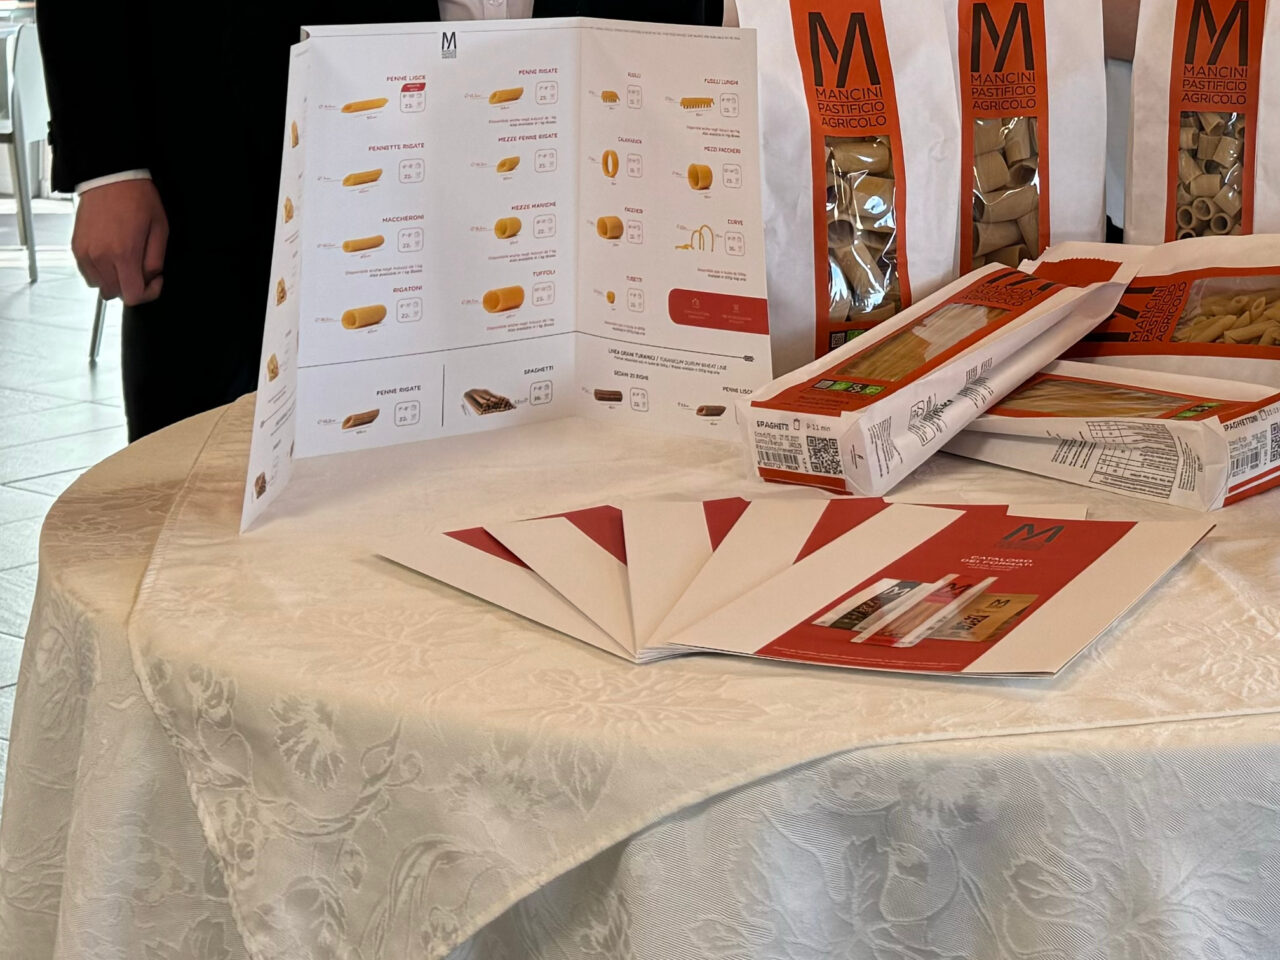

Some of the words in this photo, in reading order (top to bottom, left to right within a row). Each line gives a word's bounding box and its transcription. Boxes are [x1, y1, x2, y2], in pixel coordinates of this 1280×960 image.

[971, 2, 1035, 72] M
[808, 11, 881, 88] M
[971, 72, 1035, 85] MANCINI
[1184, 66, 1248, 78] MANCINI
[972, 86, 1036, 97] PASTIFICIO
[1182, 79, 1247, 91] PASTIFICIO
[815, 86, 883, 101] MANCINI
[1181, 92, 1246, 105] AGRICOLO
[817, 101, 885, 114] PASTIFICIO
[972, 98, 1036, 110] AGRICOLO
[821, 115, 887, 128] AGRICOLO
[382, 215, 425, 223] MACCHERONI
[393, 285, 423, 293] RIGATONI
[1129, 286, 1165, 342] MANCINI
[1141, 284, 1177, 342] PASTIFICIO
[1156, 281, 1188, 342] AGRICOLO
[376, 387, 398, 396] PENNE
[399, 385, 421, 393] RIGATE
[1001, 523, 1065, 544] M
